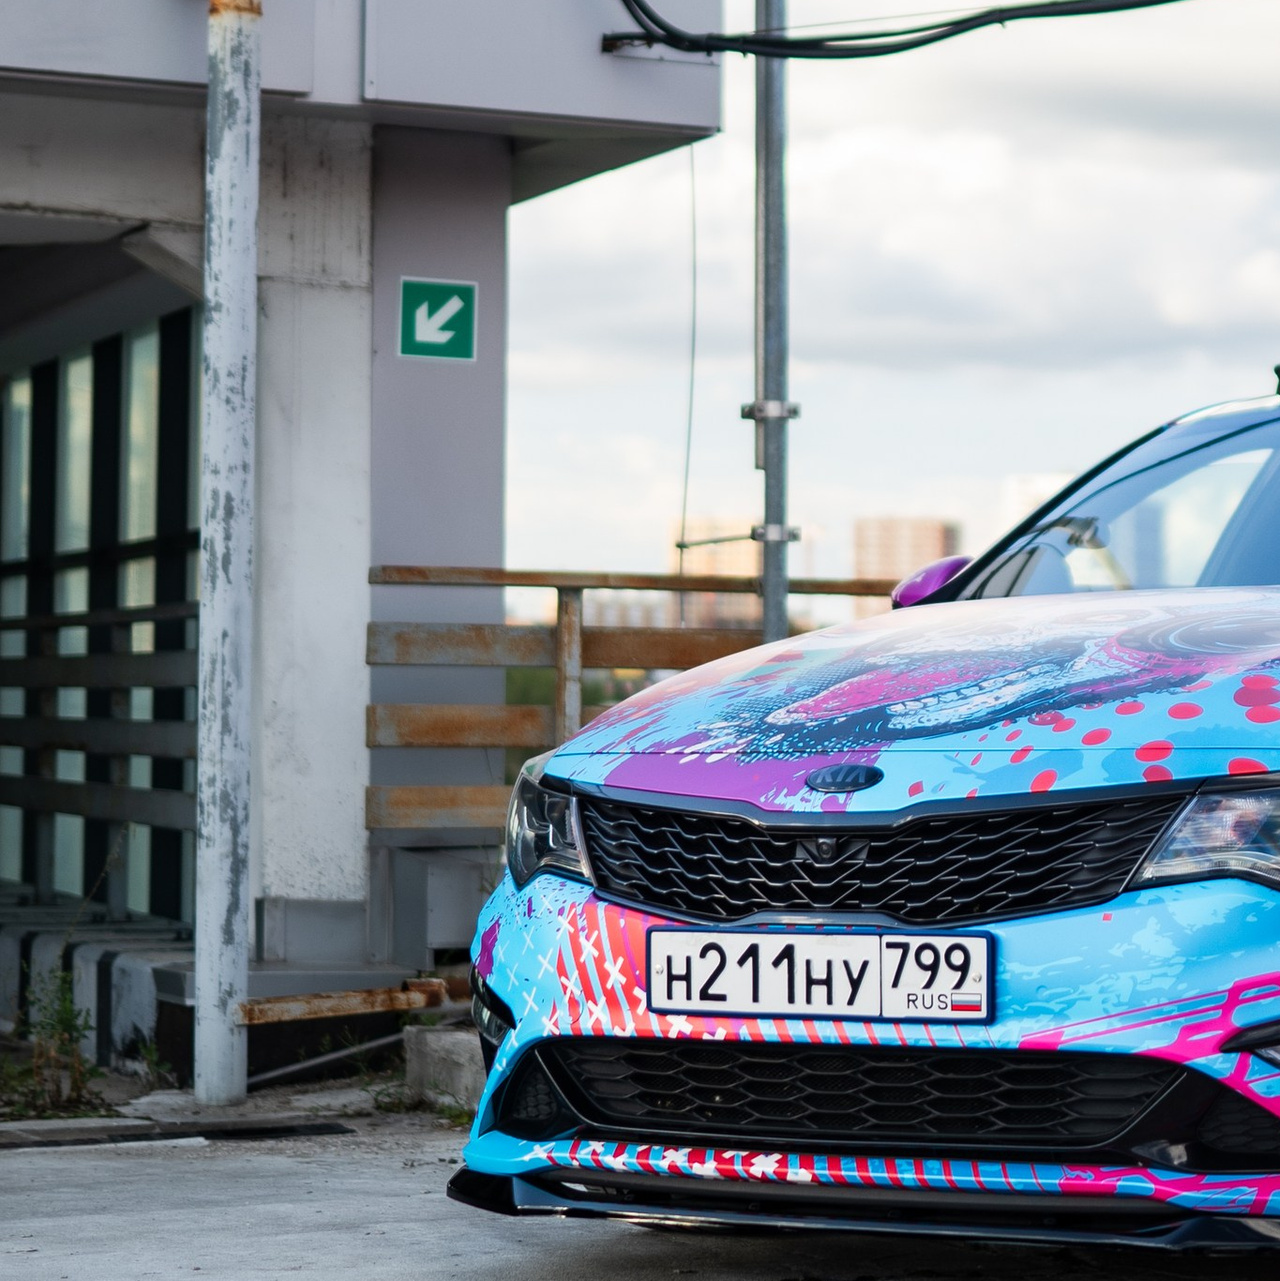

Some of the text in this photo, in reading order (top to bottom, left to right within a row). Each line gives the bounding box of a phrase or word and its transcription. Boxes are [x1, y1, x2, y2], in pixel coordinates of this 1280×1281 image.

[815, 765, 868, 784] KIA
[885, 941, 971, 990] 799
[906, 993, 949, 1010] RUS
